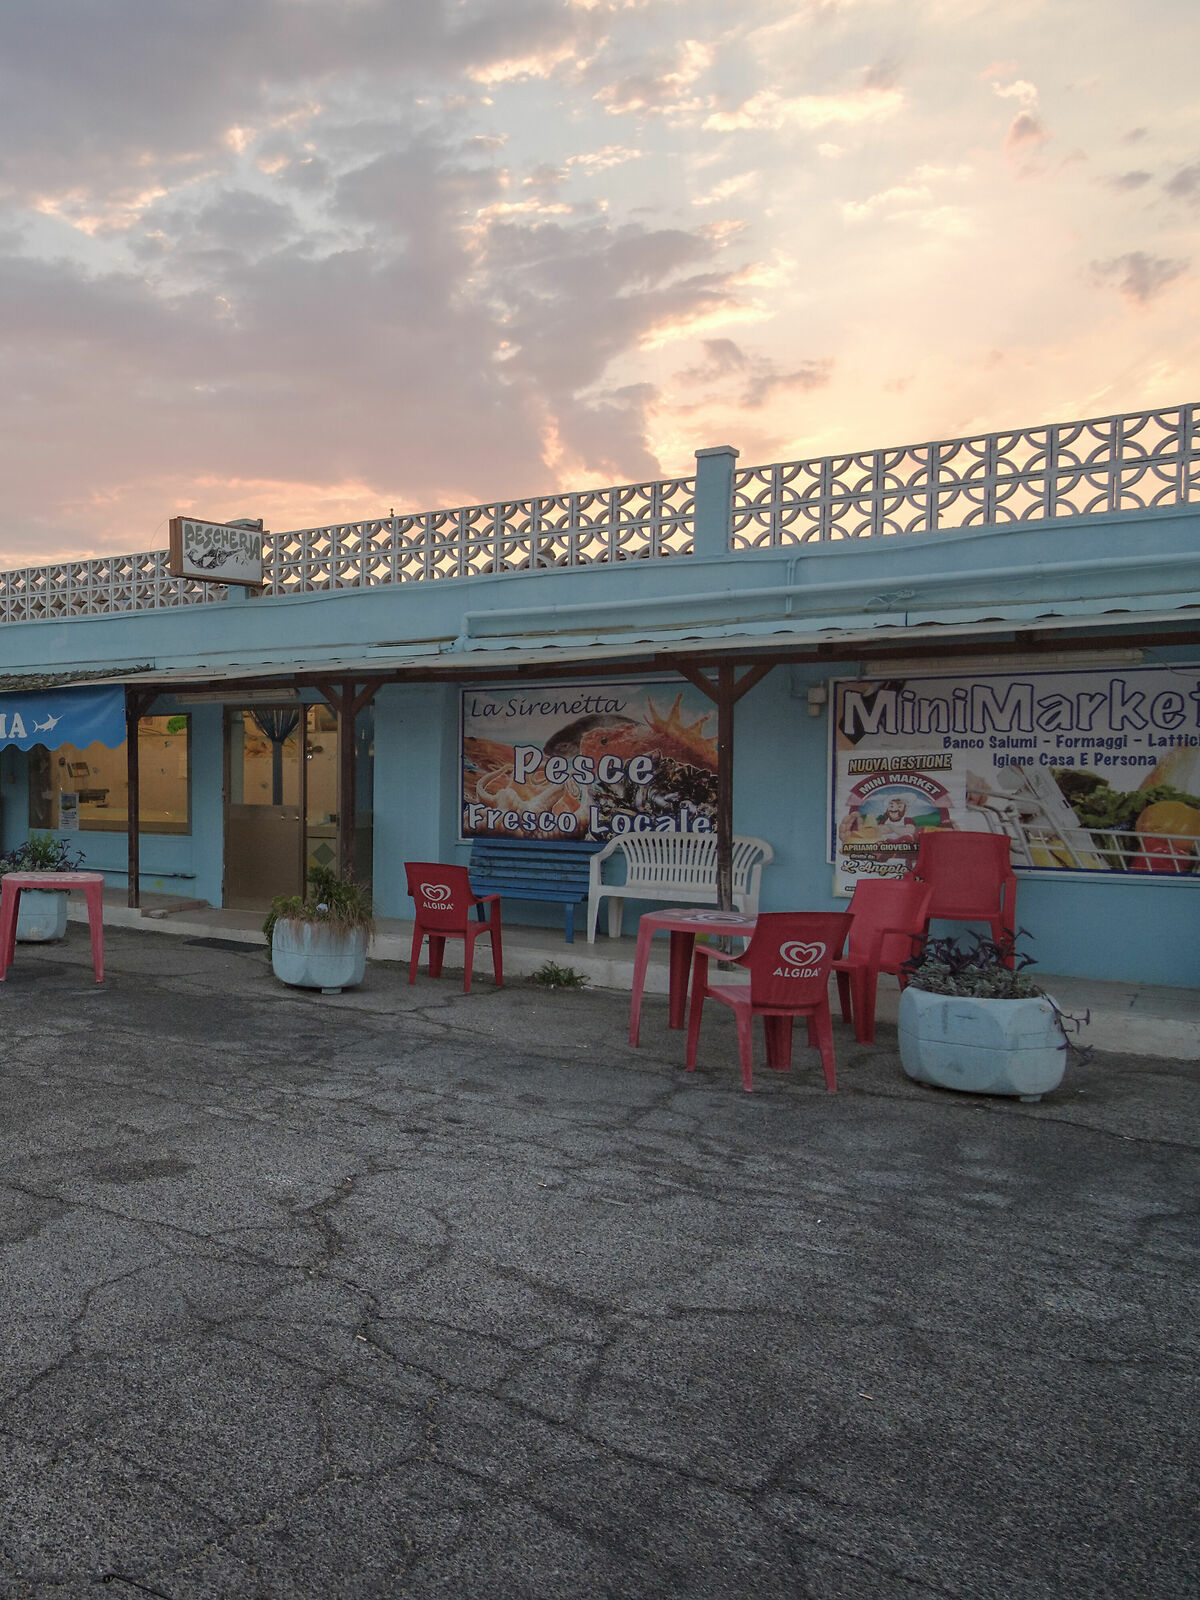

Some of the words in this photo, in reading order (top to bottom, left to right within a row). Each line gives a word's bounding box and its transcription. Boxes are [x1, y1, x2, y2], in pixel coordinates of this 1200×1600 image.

[184, 523, 260, 561] PESCHERIA
[471, 699, 502, 717] La
[505, 694, 627, 717] Sirenetta
[943, 736, 985, 749] Banco
[989, 735, 1037, 749] Salumi
[1056, 734, 1128, 750] Formaggi
[513, 745, 655, 785] Pesce
[849, 758, 890, 773] NUOVA
[891, 754, 953, 770] GESTIONE
[993, 753, 1036, 768] Igiene
[1039, 753, 1076, 767] Casa
[1080, 753, 1089, 766] E
[1095, 752, 1157, 766] Persona
[858, 776, 887, 795] MINI
[889, 774, 941, 795] MARKET
[466, 803, 578, 833] Fresco
[589, 804, 713, 834] Locale
[423, 901, 453, 910] ALGIDA
[772, 967, 819, 978] ALGIDA
